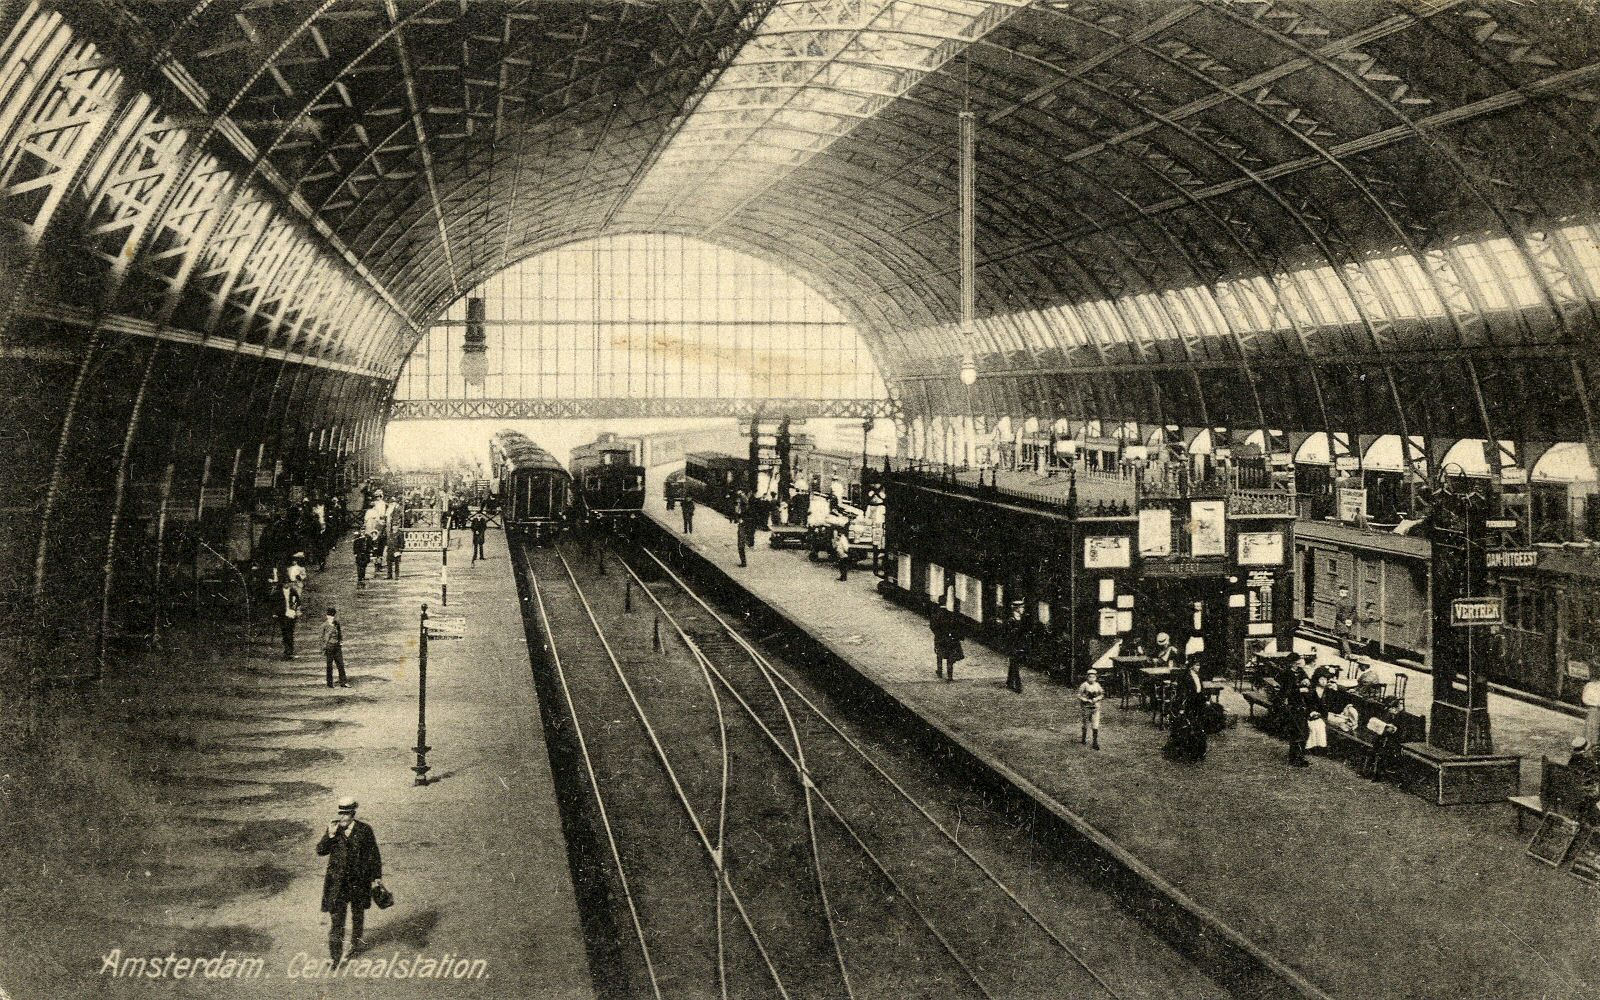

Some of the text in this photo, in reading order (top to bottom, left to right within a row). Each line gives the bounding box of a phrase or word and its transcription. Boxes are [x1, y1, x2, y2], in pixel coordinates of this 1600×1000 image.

[403, 531, 442, 541] LOOKER'S
[404, 540, 442, 549] OCOLADE
[1486, 552, 1538, 567] DAM-UITGEEST
[1454, 603, 1500, 620] VERTREK
